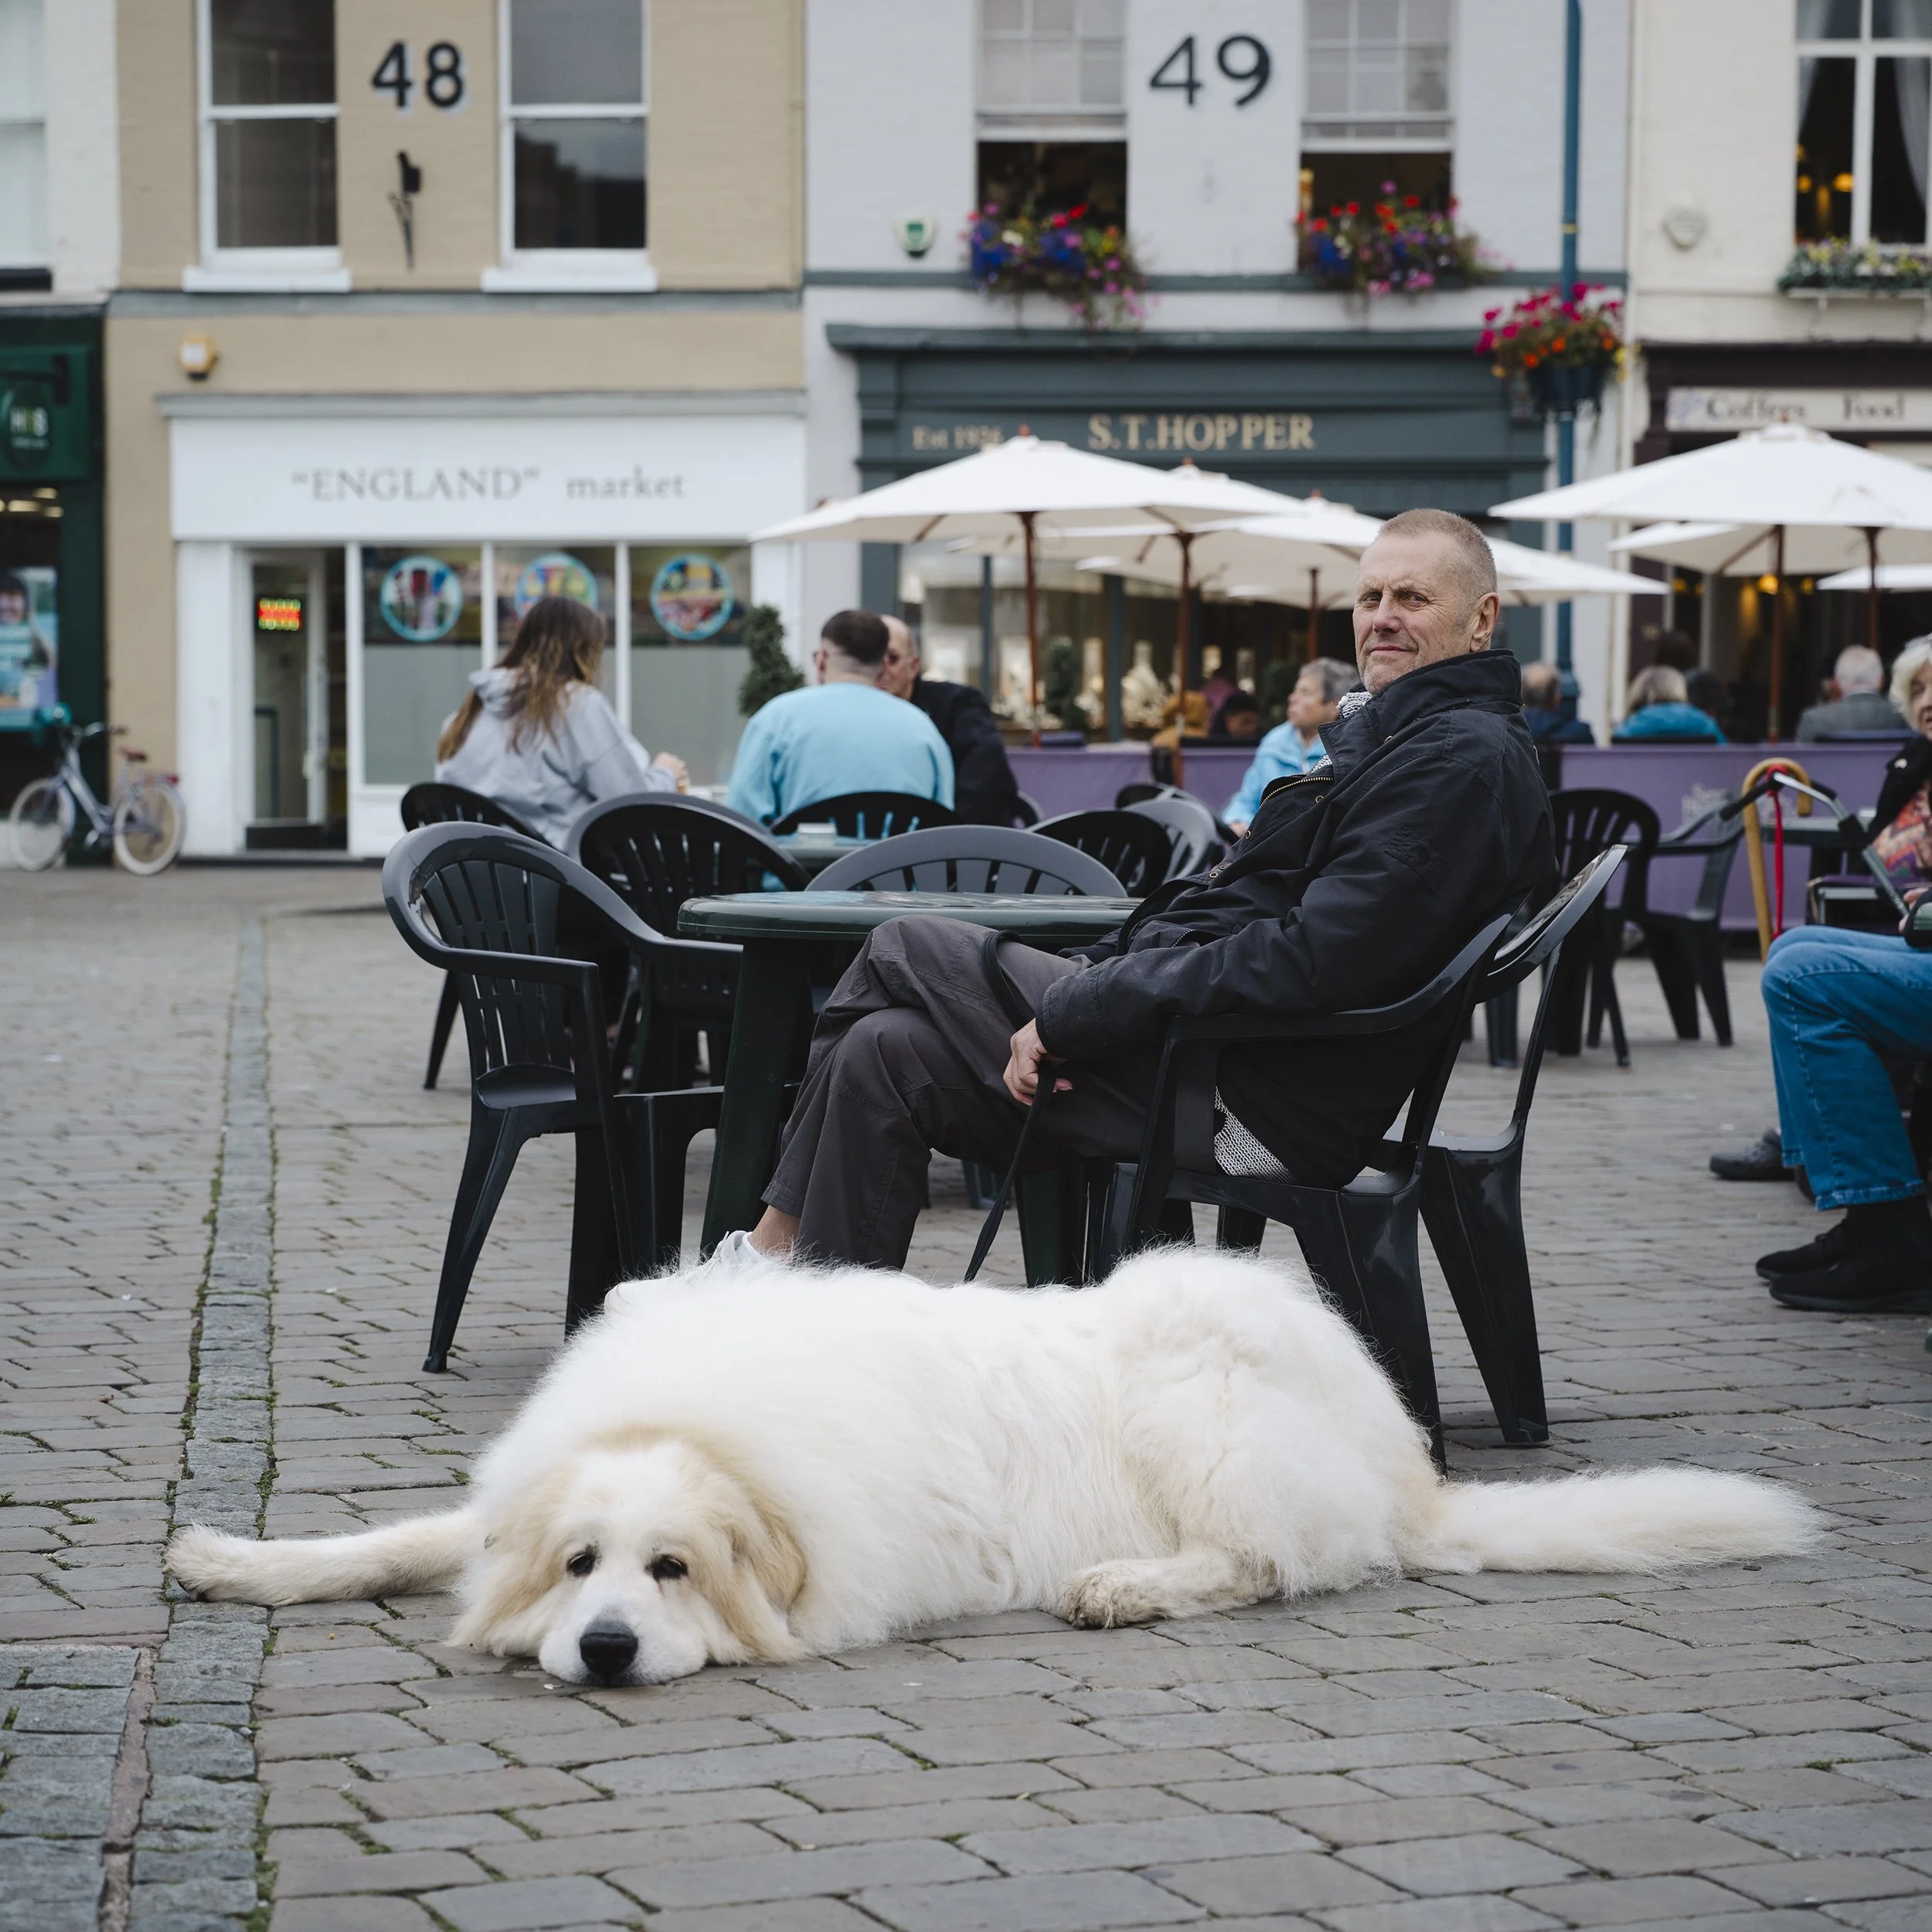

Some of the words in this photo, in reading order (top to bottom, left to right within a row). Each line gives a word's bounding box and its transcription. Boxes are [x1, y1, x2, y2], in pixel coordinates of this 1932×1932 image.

[370, 39, 464, 111] 48
[1148, 34, 1271, 107] 49
[1842, 391, 1906, 420] Food
[911, 424, 949, 451] Est
[564, 464, 687, 500] market
